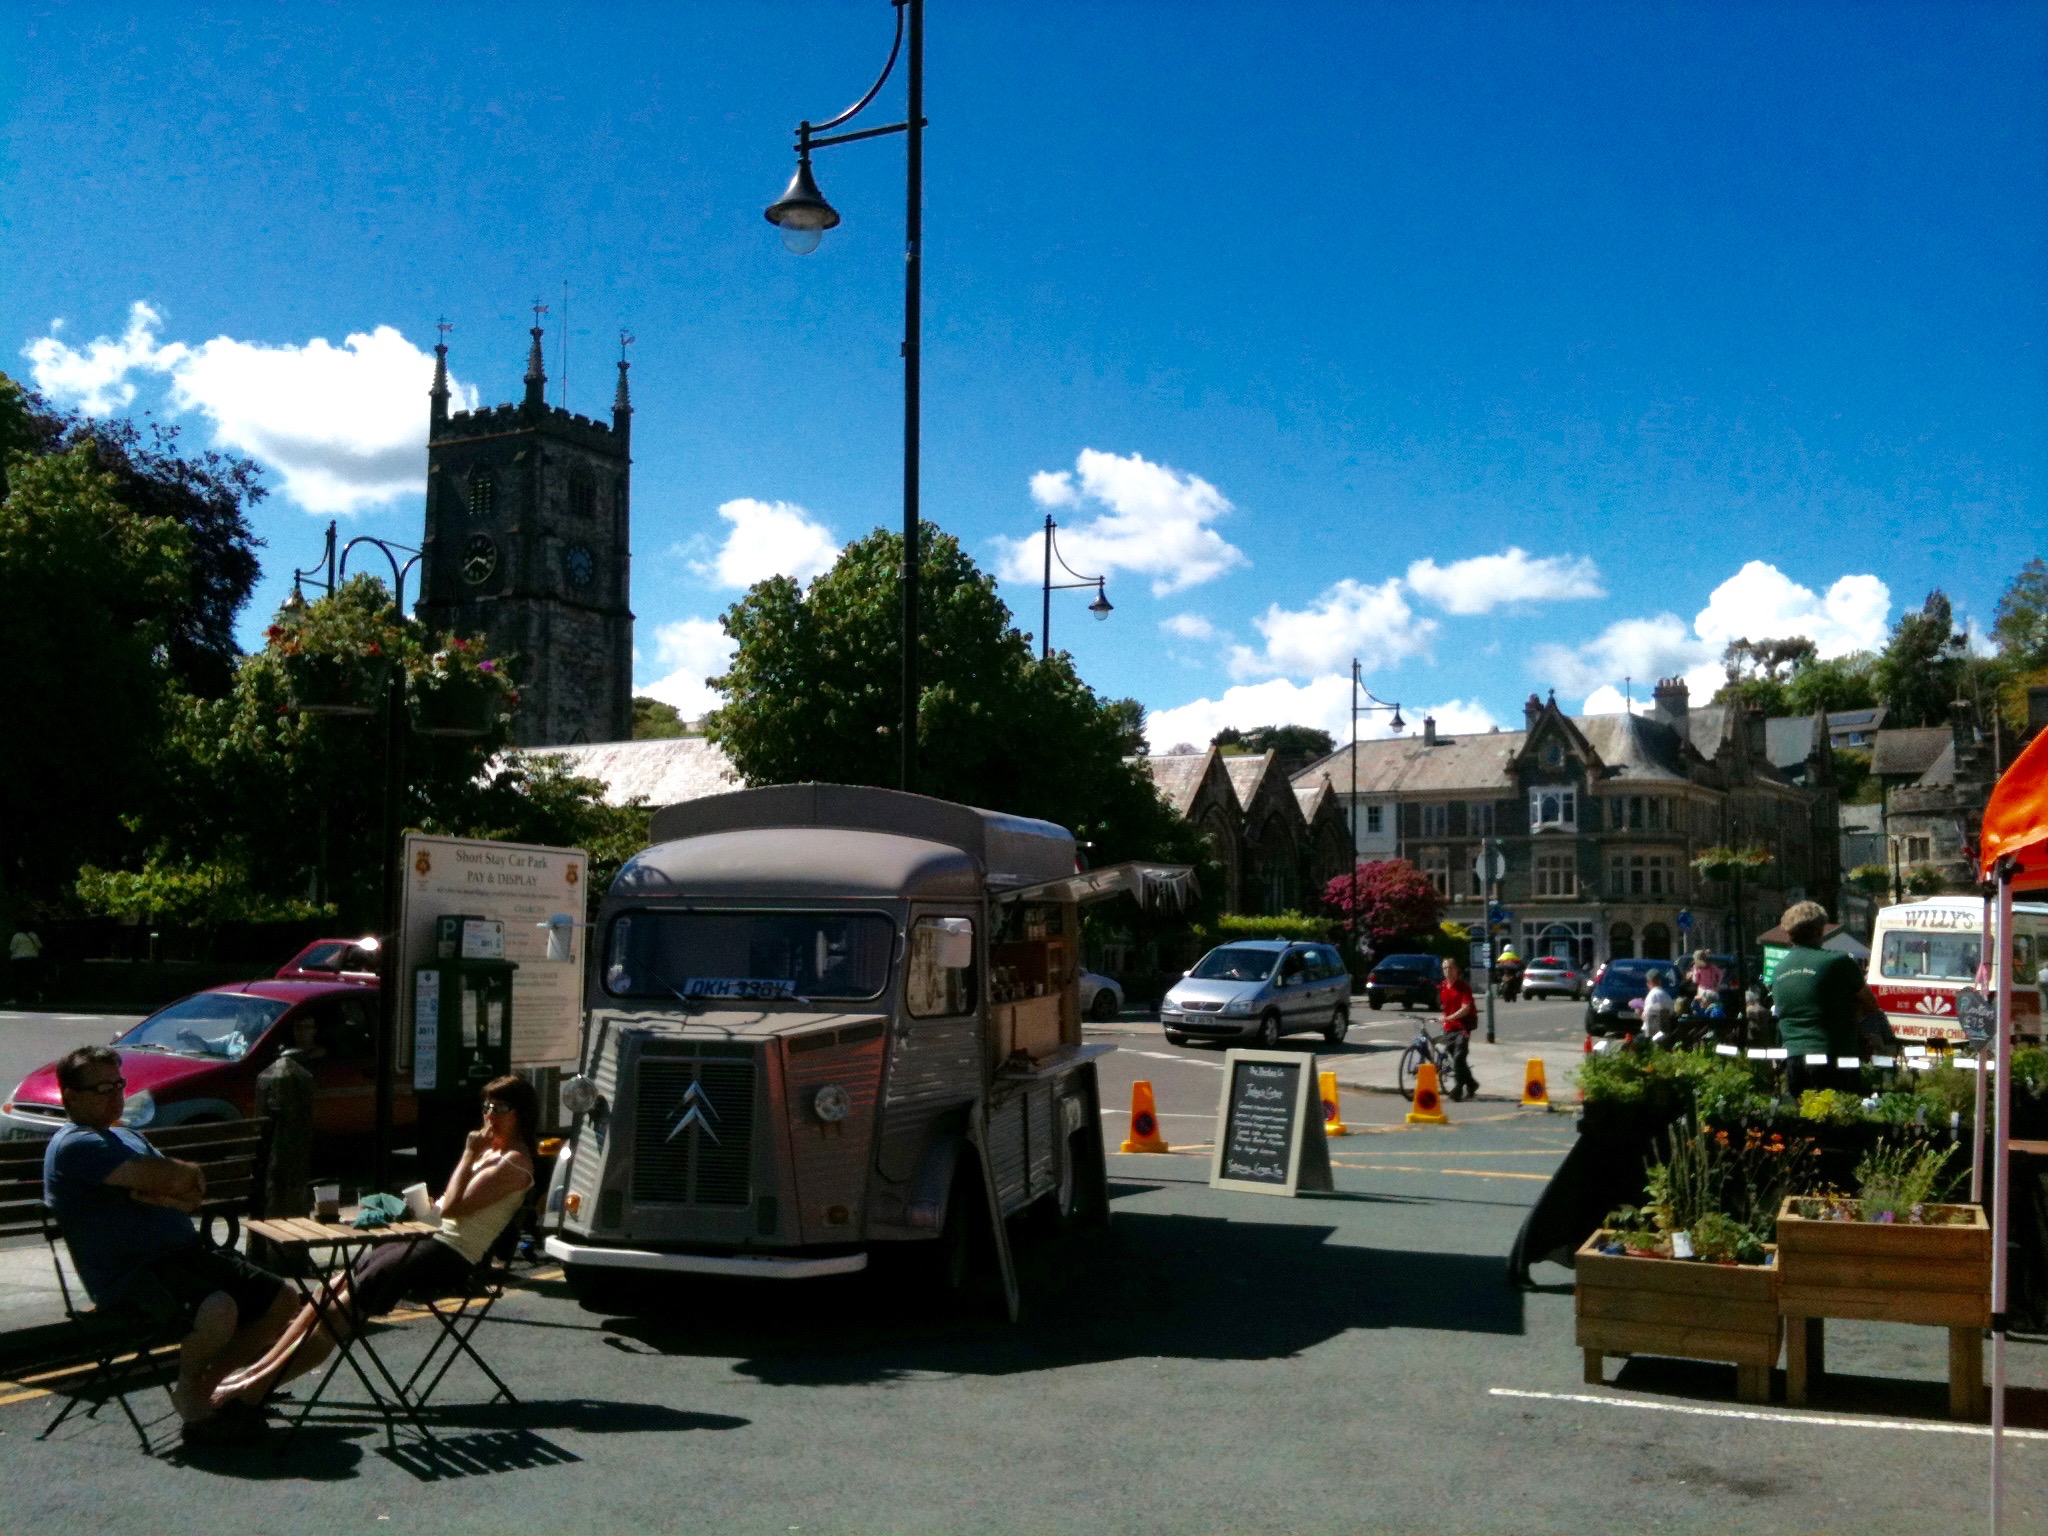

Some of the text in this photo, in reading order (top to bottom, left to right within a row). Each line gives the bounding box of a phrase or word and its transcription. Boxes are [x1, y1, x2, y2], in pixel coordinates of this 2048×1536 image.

[456, 850, 549, 869] Short Stay Car Park
[467, 871, 538, 887] PAY & DISPLAY
[1905, 909, 1976, 930] WILLY'S
[443, 919, 457, 941] P
[1902, 1024, 1928, 1037] WATCH
[1929, 1026, 1945, 1039] FOR
